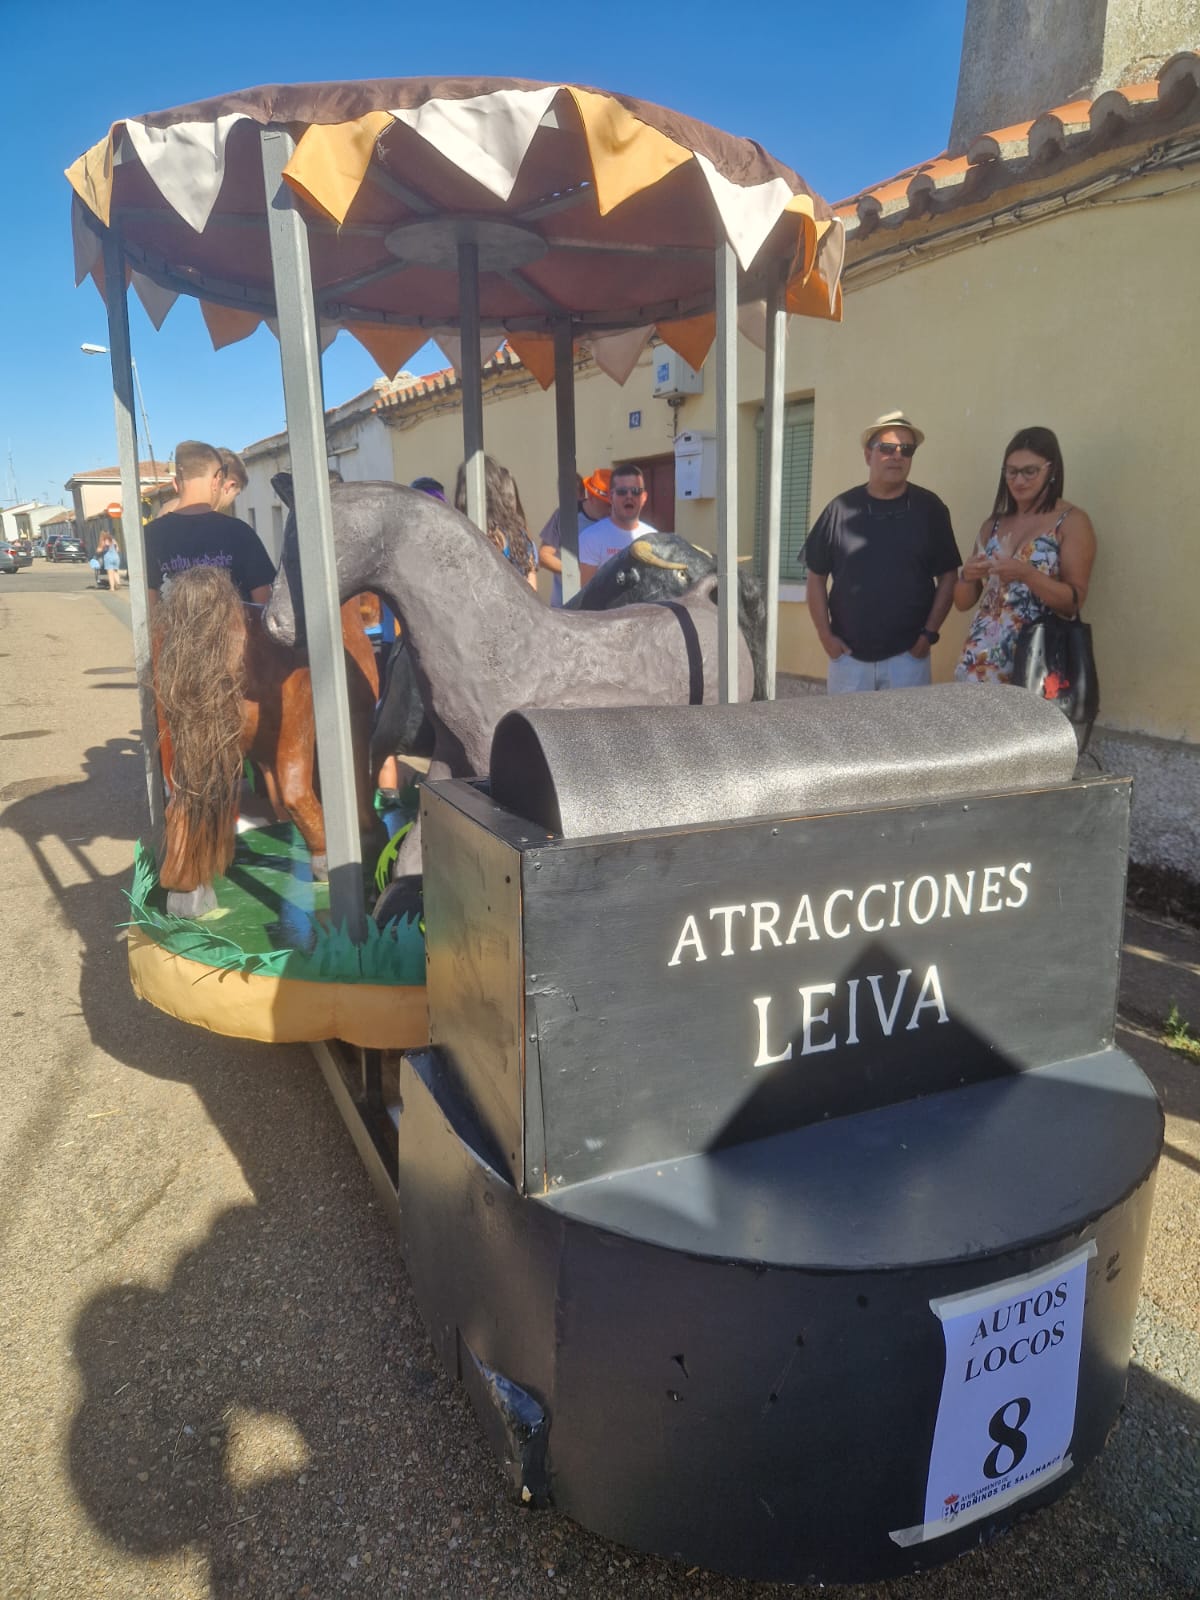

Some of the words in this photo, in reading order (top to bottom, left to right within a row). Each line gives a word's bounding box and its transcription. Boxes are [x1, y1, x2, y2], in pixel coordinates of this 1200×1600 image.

[667, 862, 1032, 967] ATRACCIONES
[752, 964, 950, 1067] LEIVA
[970, 1282, 1068, 1346] AUTOS
[964, 1320, 1065, 1383] LOCOS
[983, 1397, 1031, 1479] 8
[960, 1488, 998, 1511] DOÑINOS
[1001, 1482, 1012, 1491] DE
